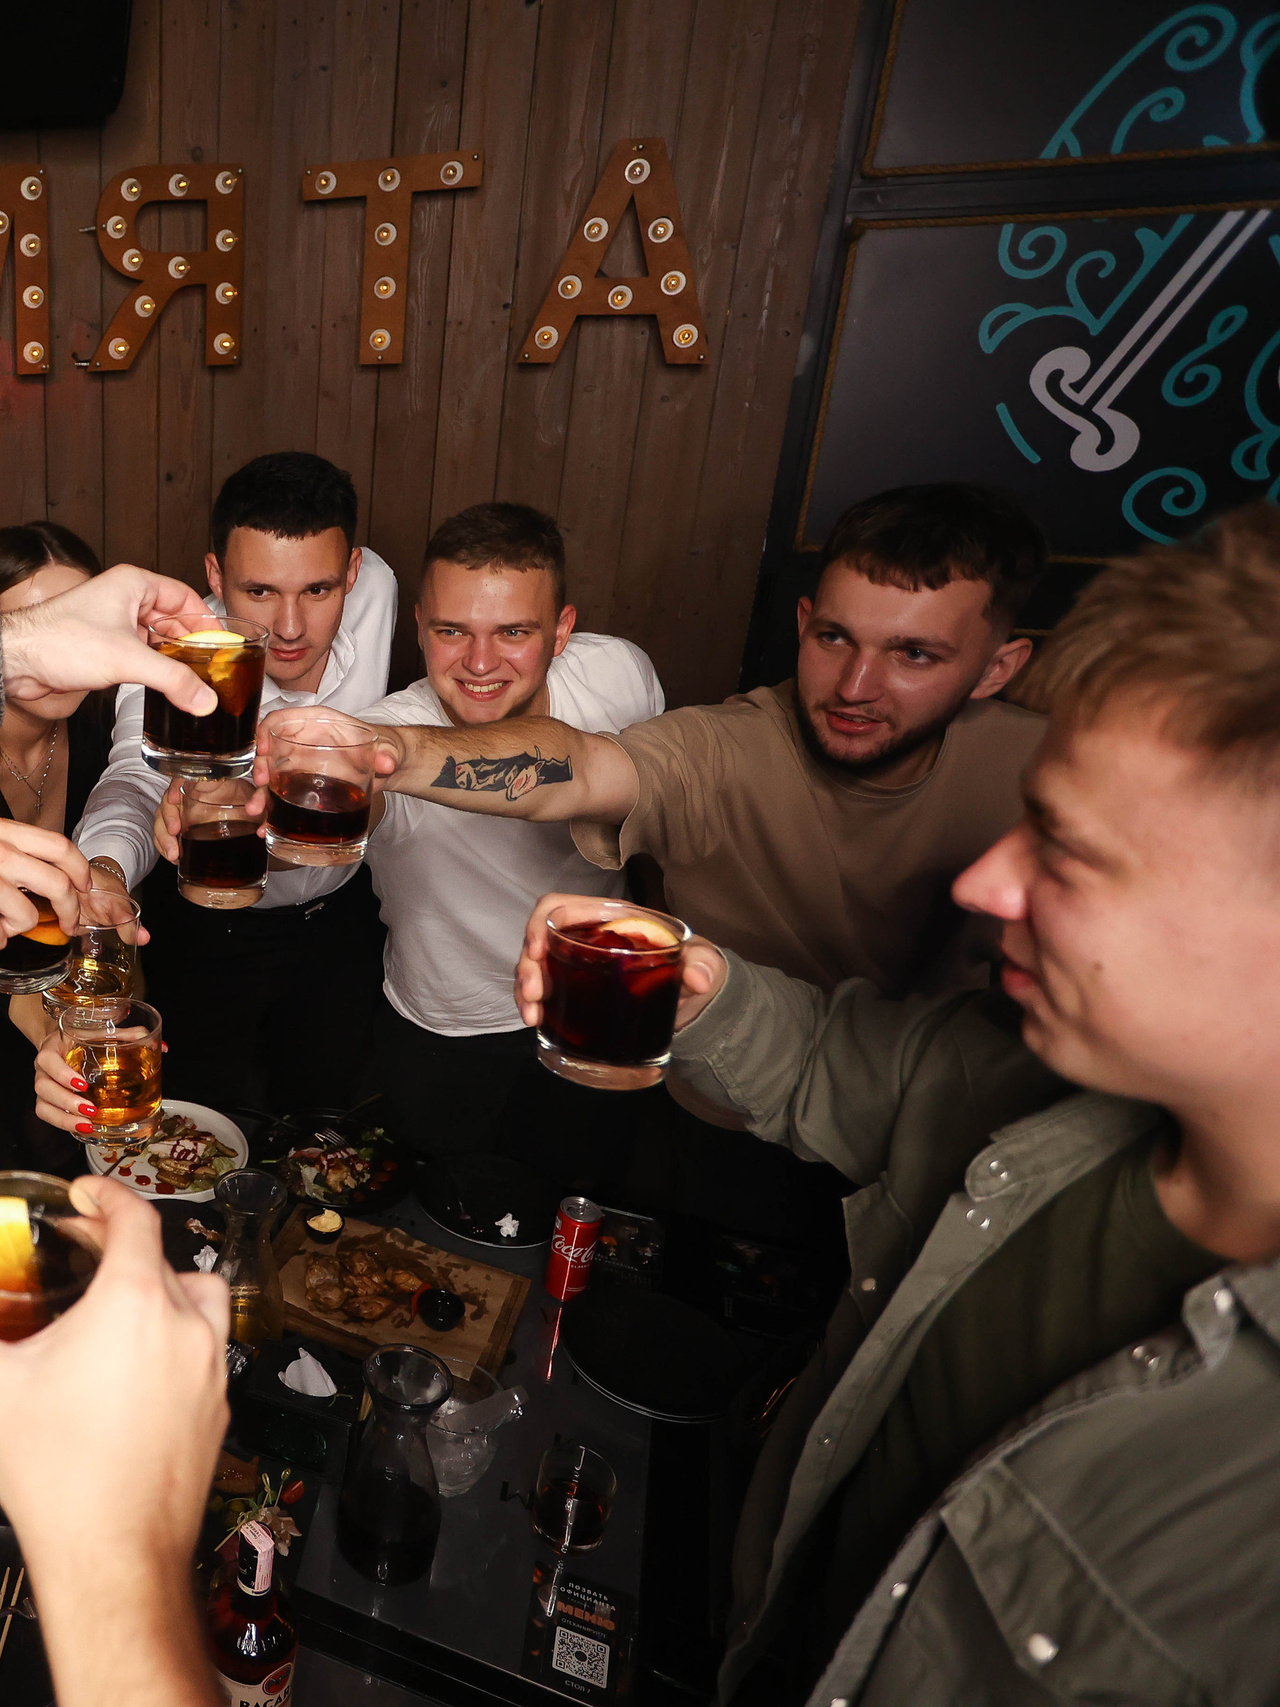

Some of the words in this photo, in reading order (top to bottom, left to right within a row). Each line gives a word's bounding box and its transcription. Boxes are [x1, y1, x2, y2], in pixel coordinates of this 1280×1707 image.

[559, 1586, 616, 1611] ОФИЦИАНТА
[568, 1582, 609, 1601] ПОЗВАТЬ
[556, 1601, 616, 1631] МЕНЮ
[564, 1679, 586, 1692] СТОЛ
